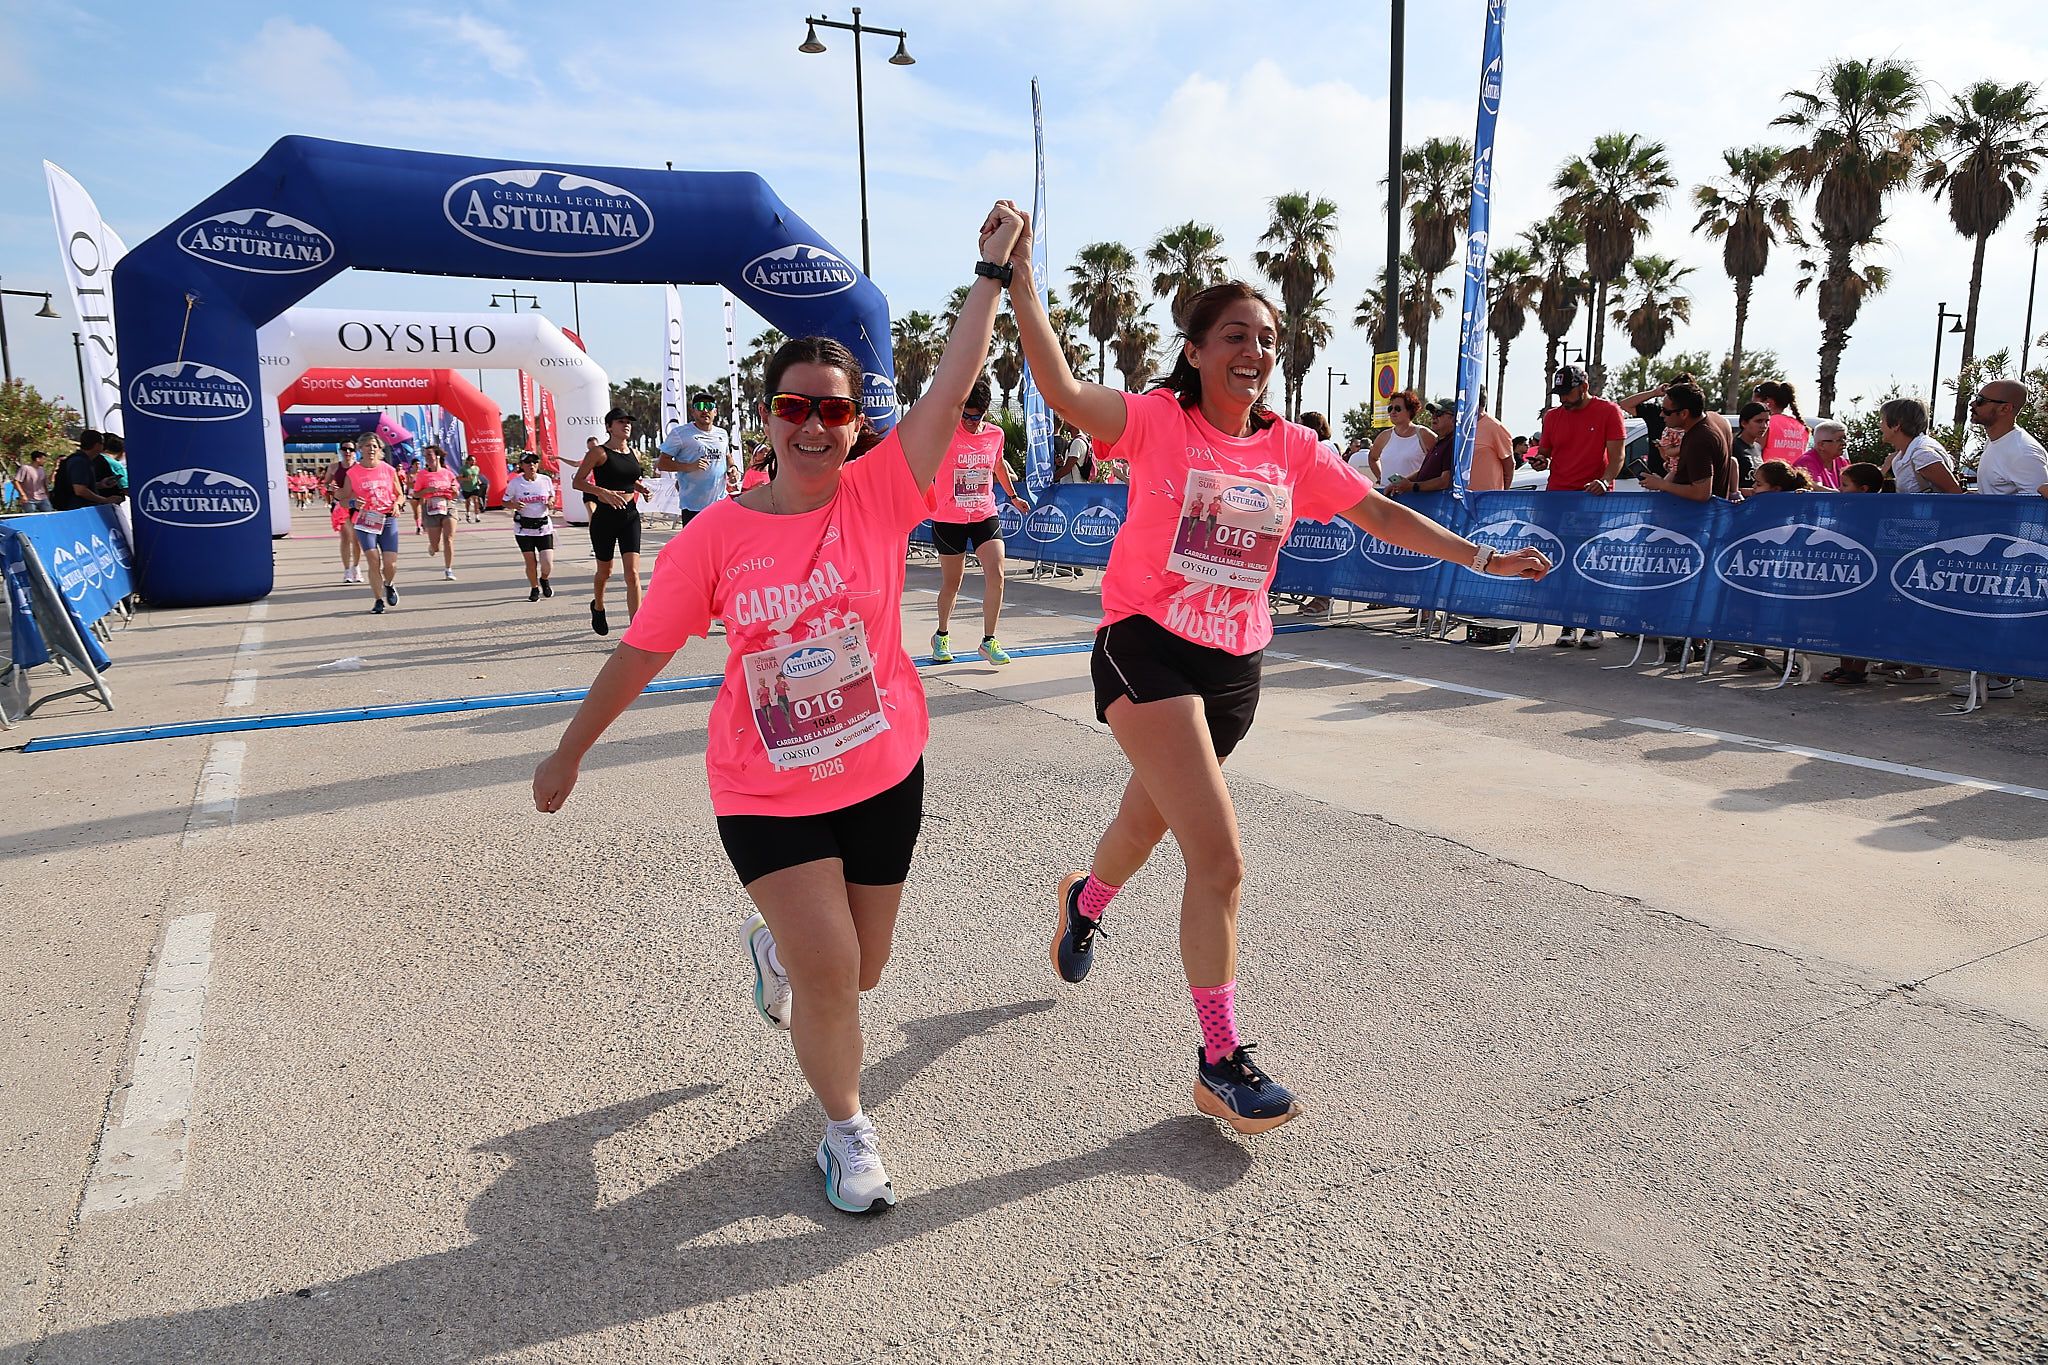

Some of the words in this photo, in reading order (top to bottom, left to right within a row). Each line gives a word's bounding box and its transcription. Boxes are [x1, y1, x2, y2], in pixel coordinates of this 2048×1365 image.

[493, 190, 560, 204] CENTRAL
[567, 196, 632, 209] LECHERA
[461, 189, 639, 238] ASTURIANA
[214, 226, 267, 237] CENTRAL
[271, 232, 321, 244] LECHERA
[188, 228, 323, 262] ASTURIANA
[753, 265, 853, 285] ASTURIANA
[338, 321, 496, 355] OYSHO
[258, 355, 290, 366] SHO
[540, 357, 583, 367] OYSHO
[301, 376, 344, 391] Sports
[363, 377, 429, 389] Santander
[135, 382, 246, 409] ASTURIANA
[958, 454, 989, 464] CARRERA
[1198, 480, 1221, 490] SUMA
[145, 490, 254, 512] ASTURIANA
[1225, 491, 1265, 508] ASTURIANA
[1028, 517, 1063, 534] ASTURIANA
[1215, 525, 1257, 549] 016
[1184, 548, 1210, 560] CARRERA
[1226, 558, 1244, 567] MUJER
[1223, 547, 1242, 558] 1044
[1581, 546, 1692, 575] ASTURIANA
[1752, 548, 1803, 558] CENTRAL
[1807, 551, 1861, 561] LECHERA
[1181, 560, 1218, 577] OYSHO
[1724, 549, 1862, 584] ASTURIANA
[1937, 559, 1998, 570] CENTRAL
[2005, 564, 2048, 574] LECH
[1902, 559, 2048, 600] ASTURIAN
[735, 561, 848, 626] CARRERA
[1205, 590, 1232, 616] LA
[1163, 597, 1239, 649] MUJER
[756, 660, 779, 671] SUMA
[786, 655, 833, 674] ASTURIANA
[794, 689, 843, 719] 016
[813, 715, 837, 729] 1043
[776, 736, 804, 747] CARRERA
[804, 733, 812, 741] DE
[813, 730, 822, 738] LA
[823, 723, 844, 736] MUJER
[843, 723, 876, 744] Santander
[782, 745, 820, 761] OYSHO
[809, 757, 845, 782] 2026
